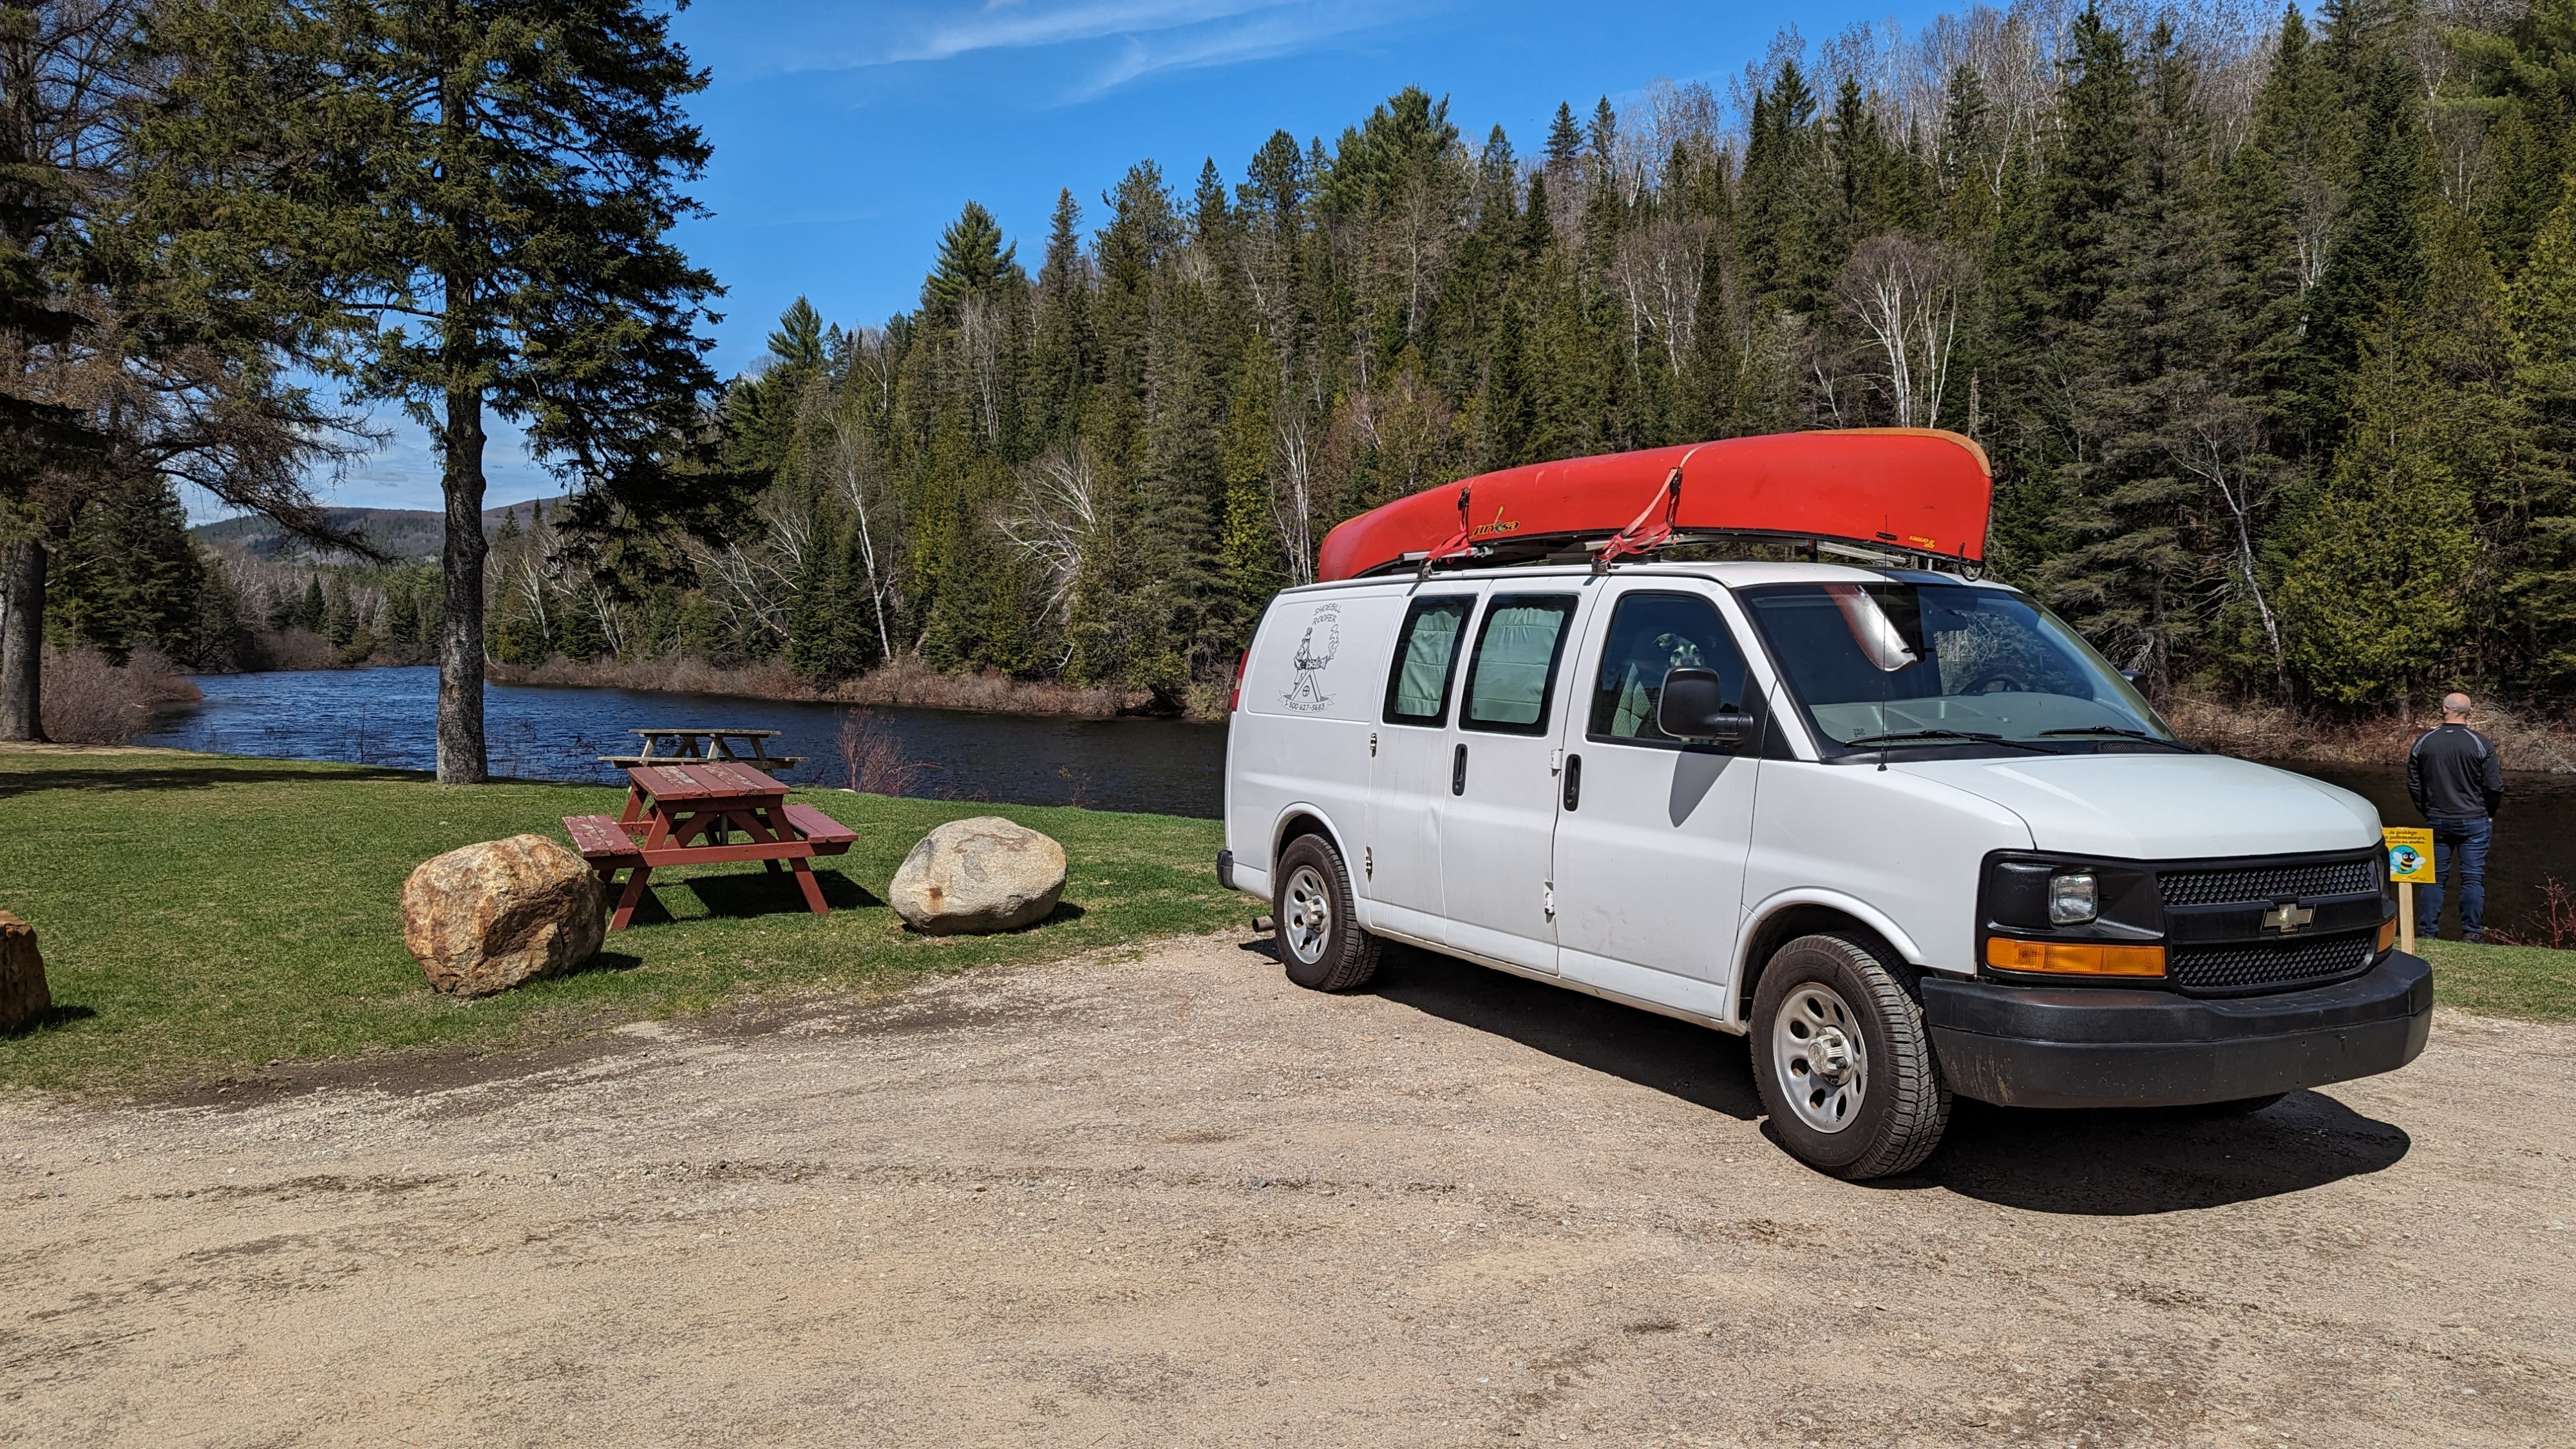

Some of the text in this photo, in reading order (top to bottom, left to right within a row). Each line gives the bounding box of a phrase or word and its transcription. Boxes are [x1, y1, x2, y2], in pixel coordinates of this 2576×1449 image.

[1313, 603, 1341, 616] SHOEBILL
[1312, 614, 1337, 625] ROOFER
[1289, 701, 1298, 710] 800
